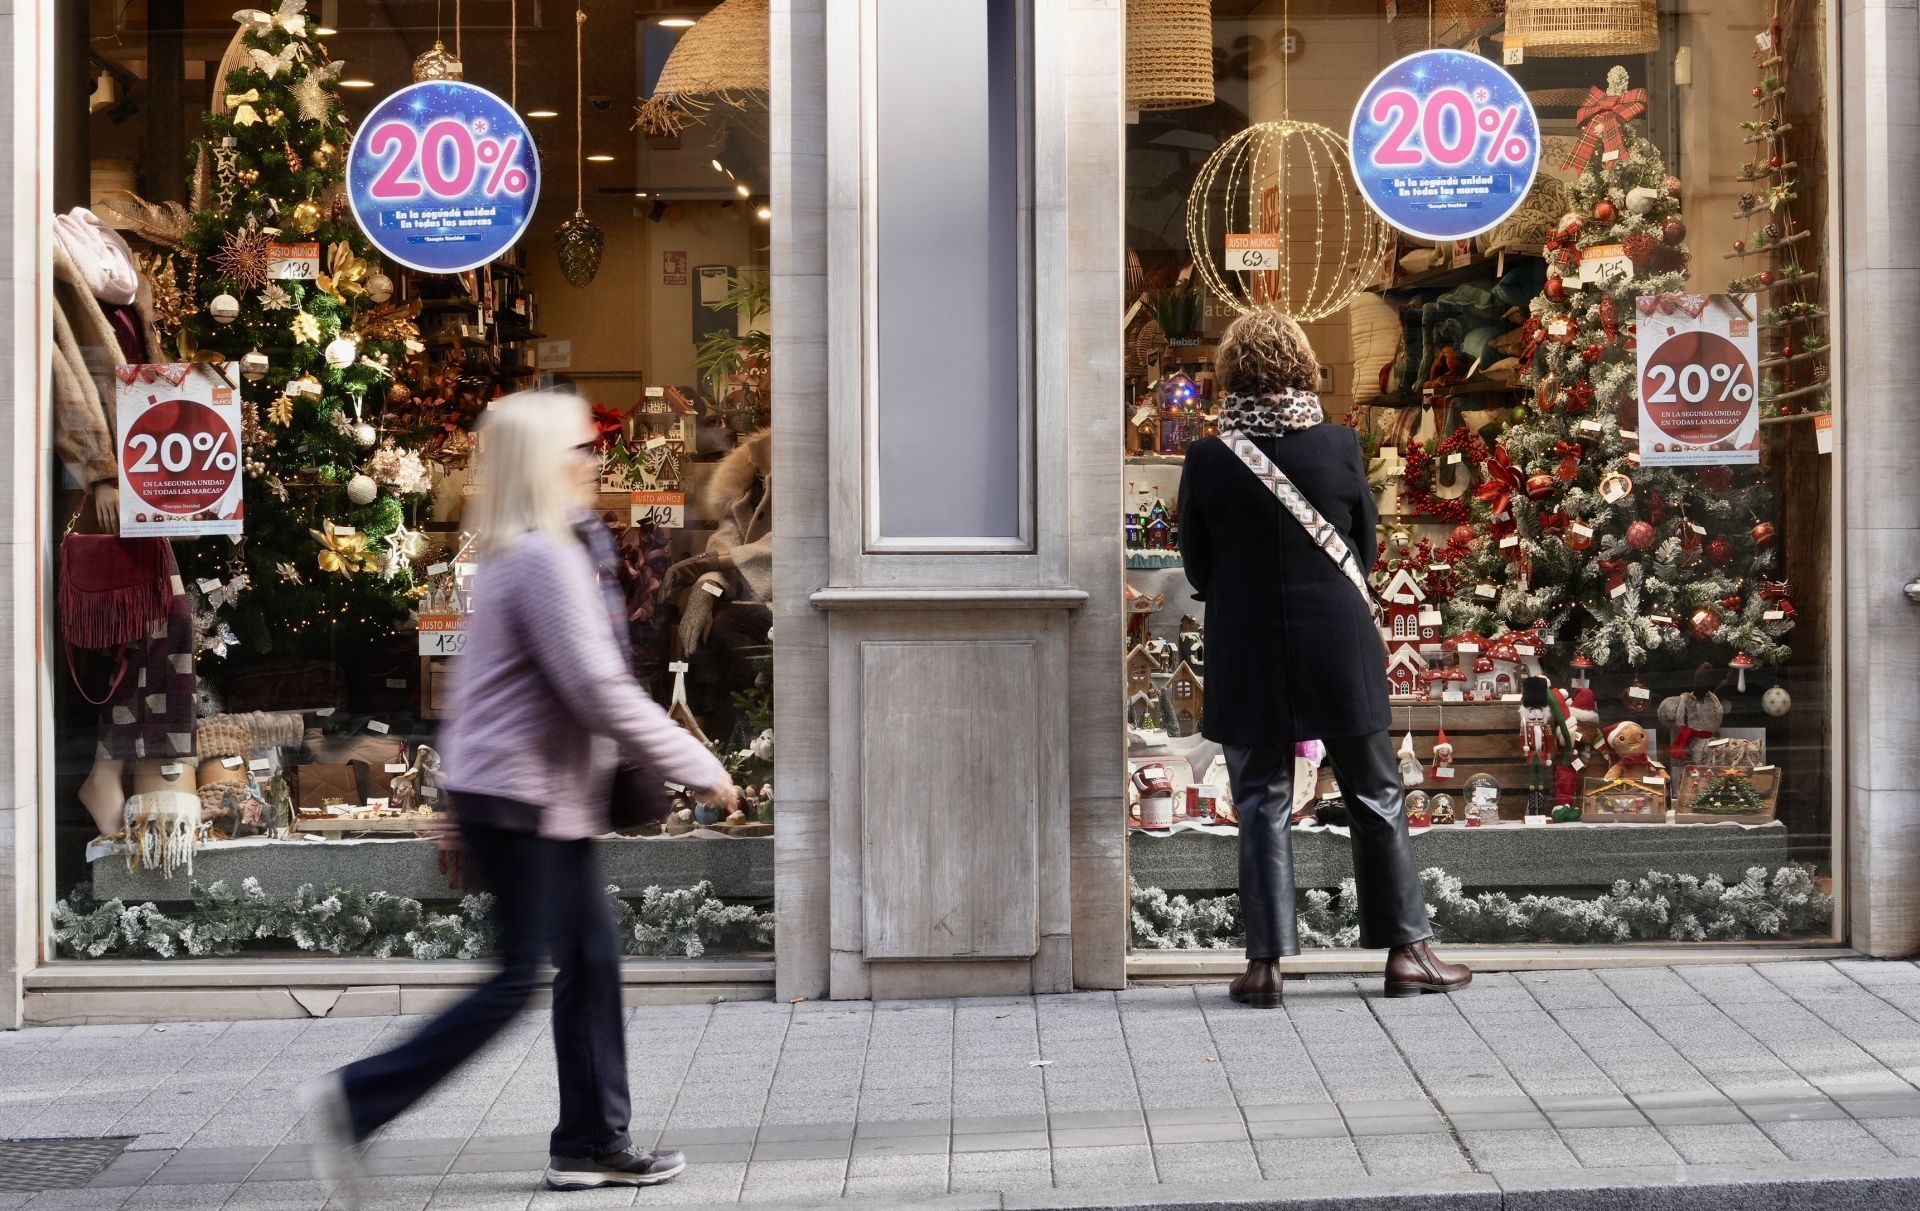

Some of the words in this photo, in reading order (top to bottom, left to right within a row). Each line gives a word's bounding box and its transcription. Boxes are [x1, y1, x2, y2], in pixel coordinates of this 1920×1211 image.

[1394, 179, 1405, 187] En
[1408, 178, 1417, 187] la
[1460, 176, 1494, 185] unidad
[1399, 188, 1411, 196] En
[1413, 187, 1439, 196] todas
[1440, 186, 1455, 195] las
[396, 211, 408, 219] En
[409, 210, 419, 219] la
[463, 207, 496, 217] unidad
[401, 220, 412, 228] En
[414, 219, 440, 228] todas
[443, 218, 457, 227] las
[1228, 238, 1249, 248] JUSTO
[1251, 236, 1276, 248] MUÑOZ
[1604, 247, 1624, 257] MUÑO
[1647, 364, 1753, 403] 20%
[1820, 418, 1832, 427] JUST
[128, 432, 237, 473] 20%
[635, 495, 655, 503] JUSTO
[657, 494, 681, 503] MUÑOZ
[422, 621, 444, 630] JUSTO
[446, 618, 469, 630] MUÑO
[436, 634, 468, 653] 139
